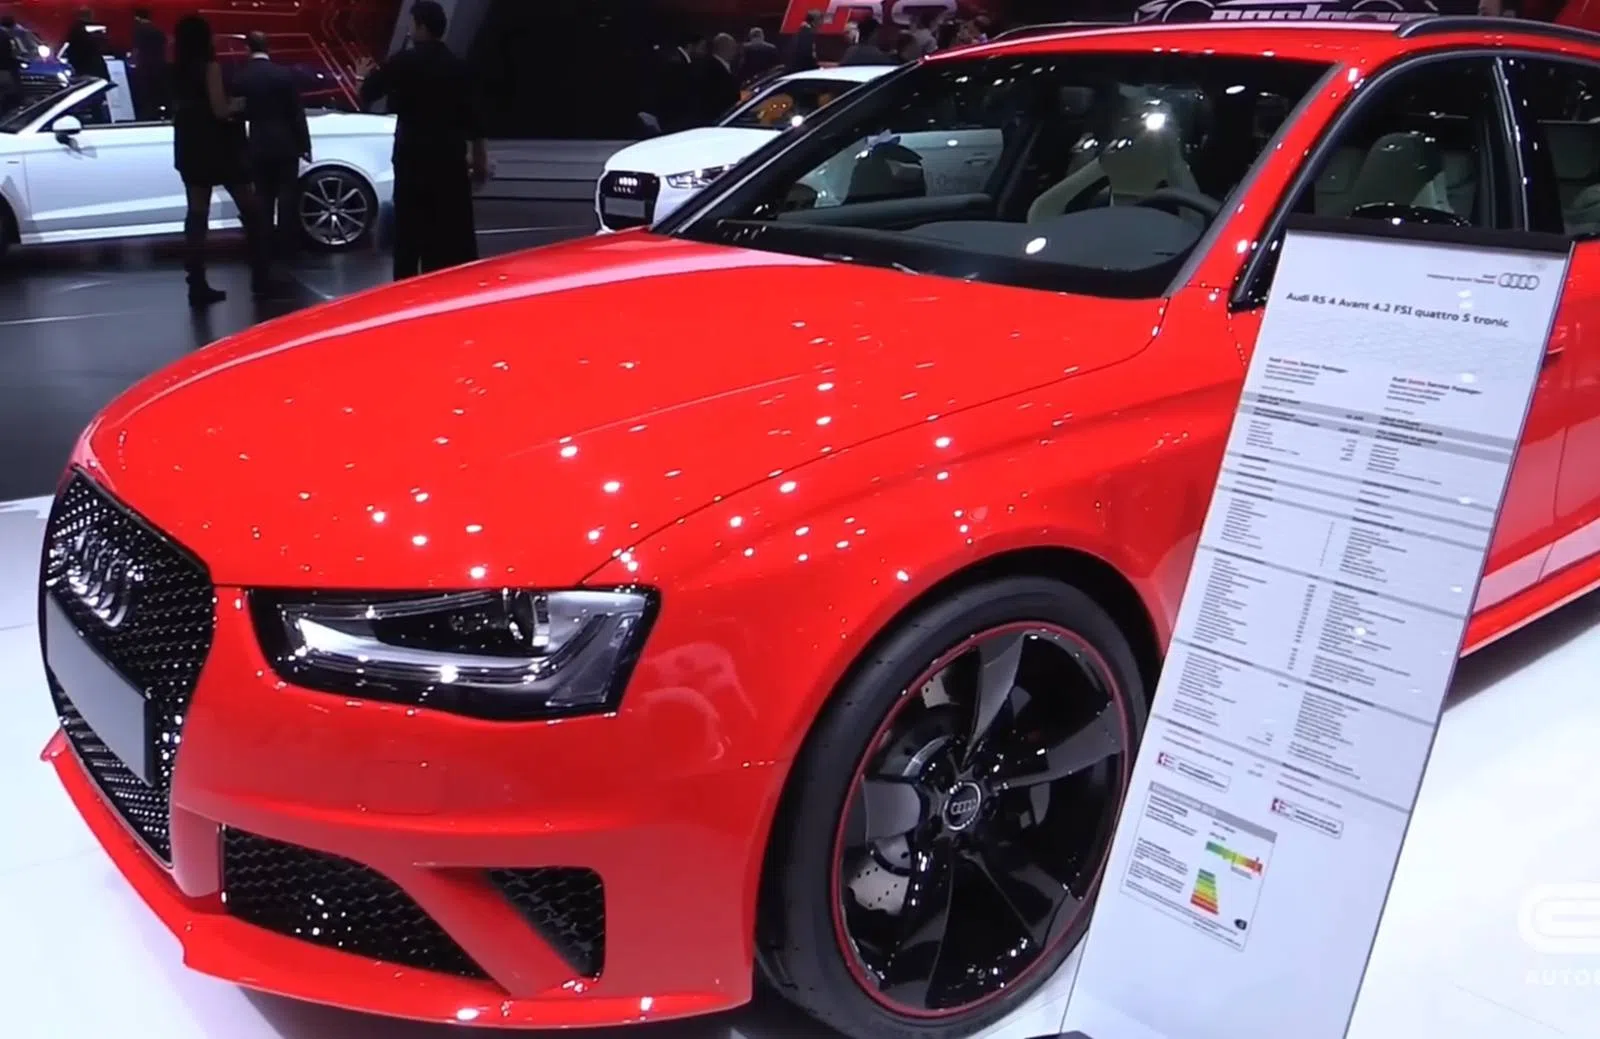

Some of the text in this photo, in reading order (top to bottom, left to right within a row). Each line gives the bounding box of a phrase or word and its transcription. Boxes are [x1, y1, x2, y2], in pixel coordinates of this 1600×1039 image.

[1286, 292, 1510, 328] Audi RS 4 Avant 4.2 FSI quattro S tronic
